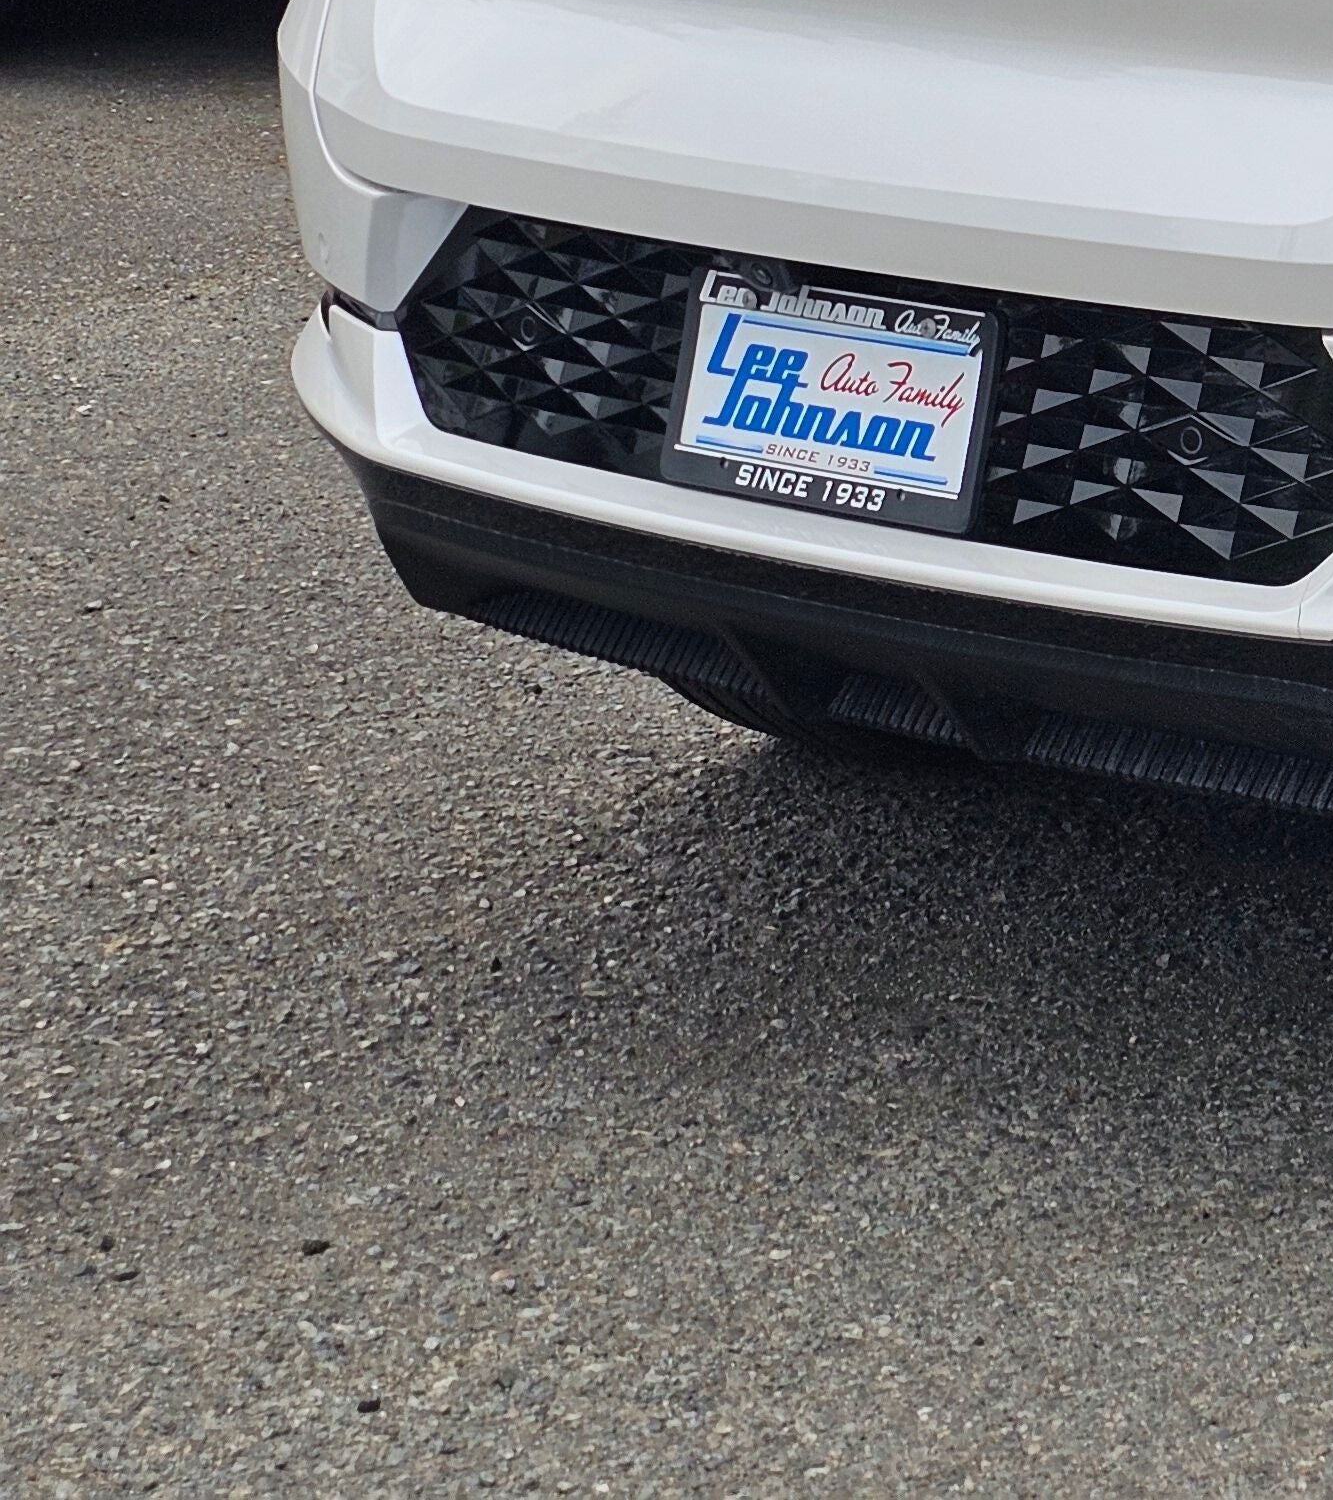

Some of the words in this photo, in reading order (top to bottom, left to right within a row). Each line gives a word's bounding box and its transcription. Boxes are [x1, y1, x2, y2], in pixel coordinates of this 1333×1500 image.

[706, 312, 809, 389] Lee
[702, 374, 937, 462] Johnson
[819, 352, 880, 398] Auto
[881, 360, 967, 428] Family
[734, 464, 813, 498] SINCE
[820, 480, 888, 513] 1933
[765, 443, 821, 464] SINCE
[827, 454, 872, 474] 1933
